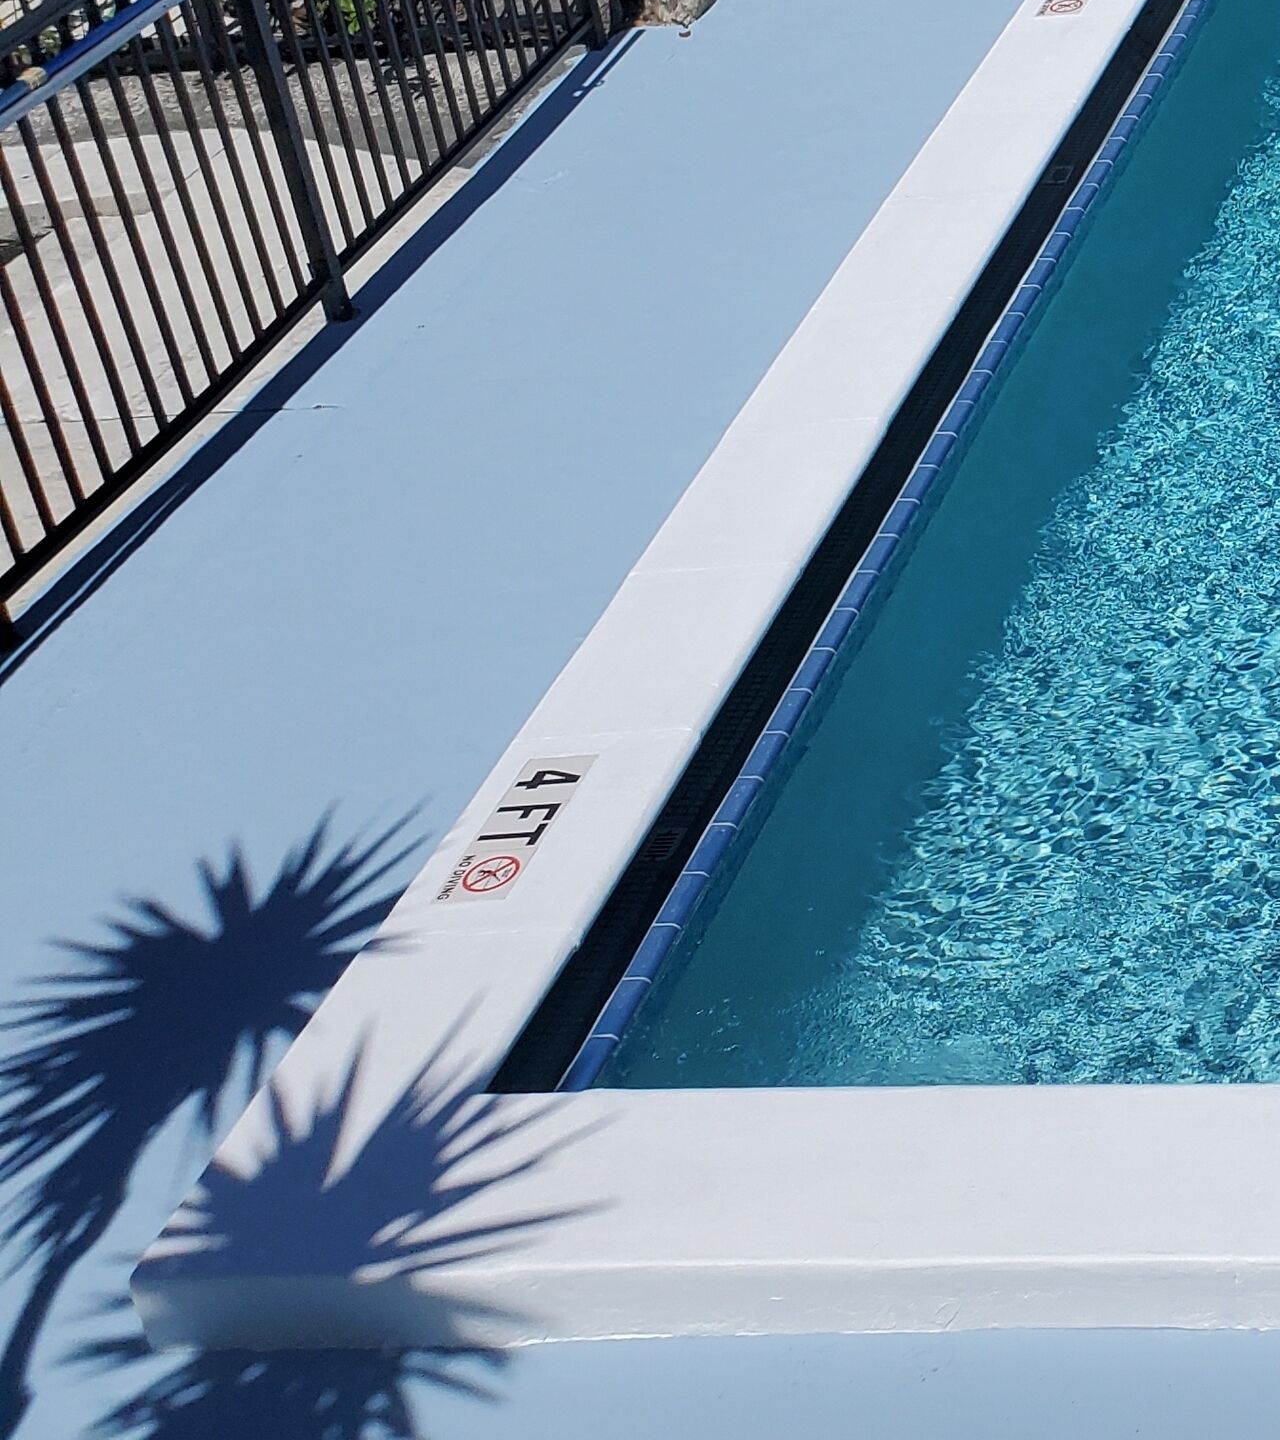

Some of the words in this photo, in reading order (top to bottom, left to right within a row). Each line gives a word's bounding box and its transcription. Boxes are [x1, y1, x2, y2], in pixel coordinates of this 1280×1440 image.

[514, 770, 582, 790] 4
[477, 803, 562, 847] FT
[458, 854, 476, 869] NO
[437, 870, 465, 901] DIVING
